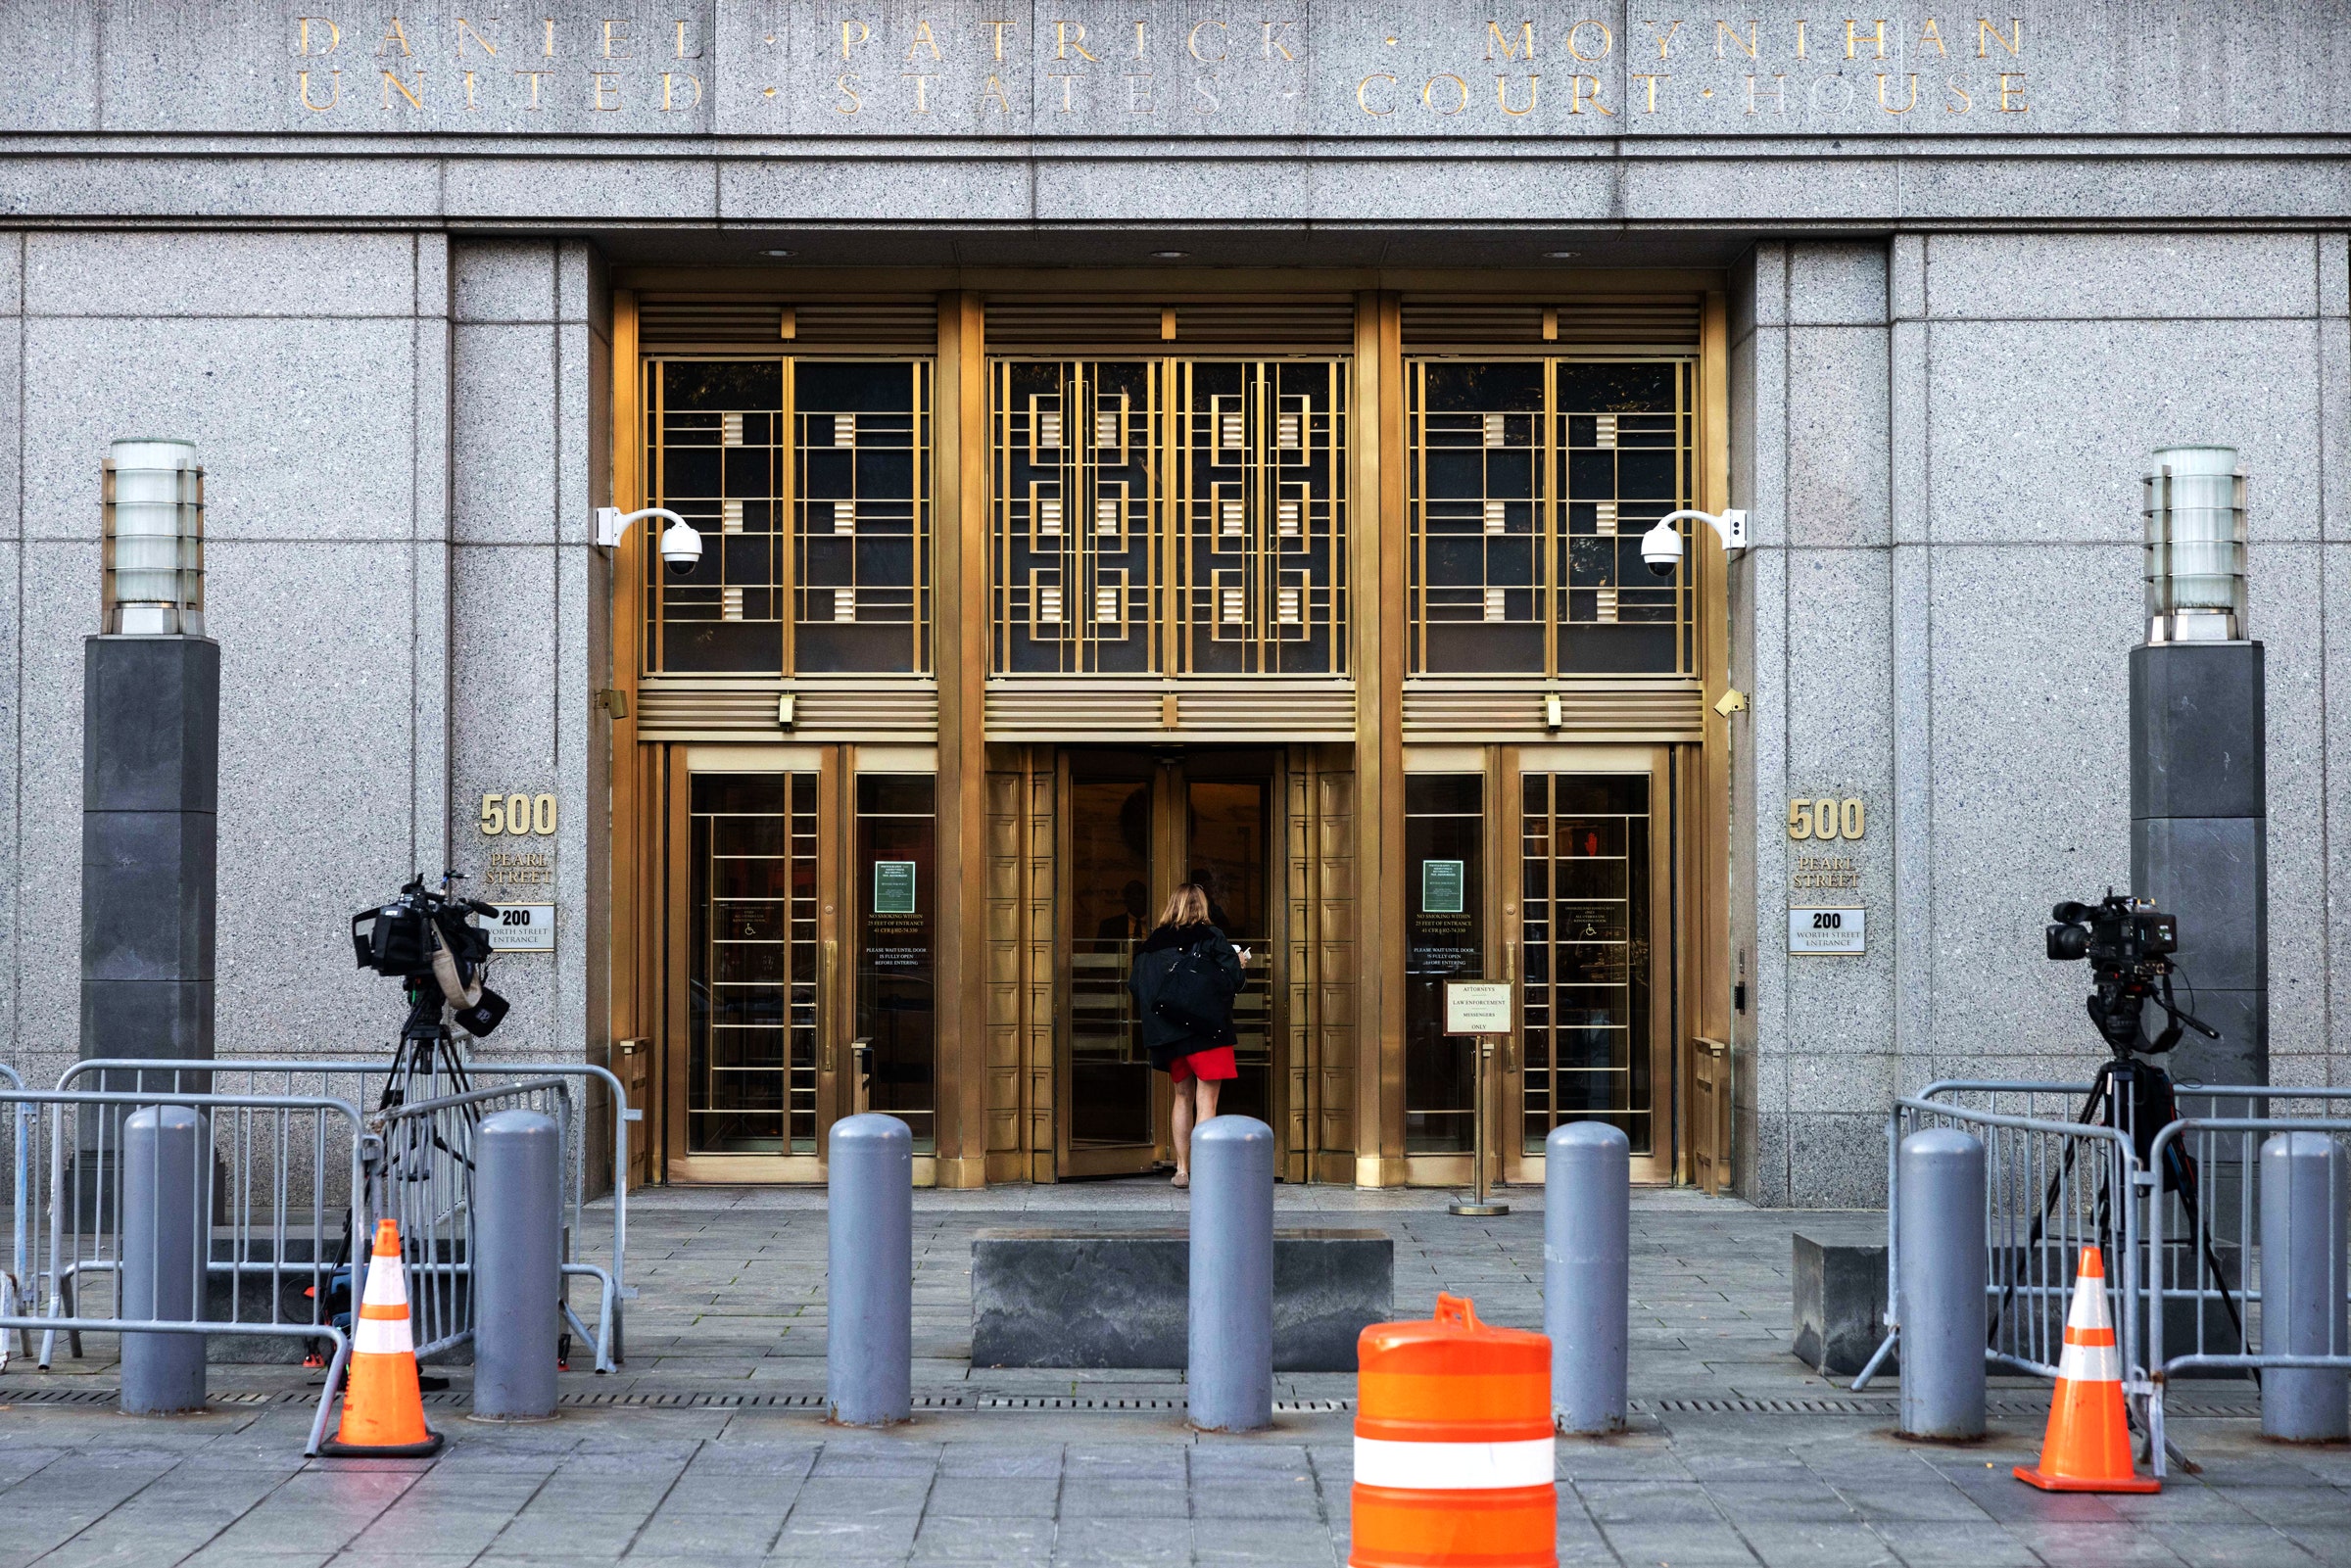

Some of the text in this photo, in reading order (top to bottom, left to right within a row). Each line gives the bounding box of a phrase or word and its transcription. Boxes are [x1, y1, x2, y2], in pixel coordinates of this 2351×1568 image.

[296, 17, 2025, 62] DANIEL PATRICK MOYNIHAN
[298, 71, 2029, 116] UNITED STATES COURT HOUSE
[481, 793, 557, 835] 500
[1789, 798, 1865, 840] 500
[491, 853, 549, 868] PEARL
[1799, 857, 1856, 872] PEARL
[486, 871, 552, 884] STREET
[1794, 875, 1860, 888] STREET
[503, 910, 531, 927] 200
[1813, 913, 1842, 929] 200
